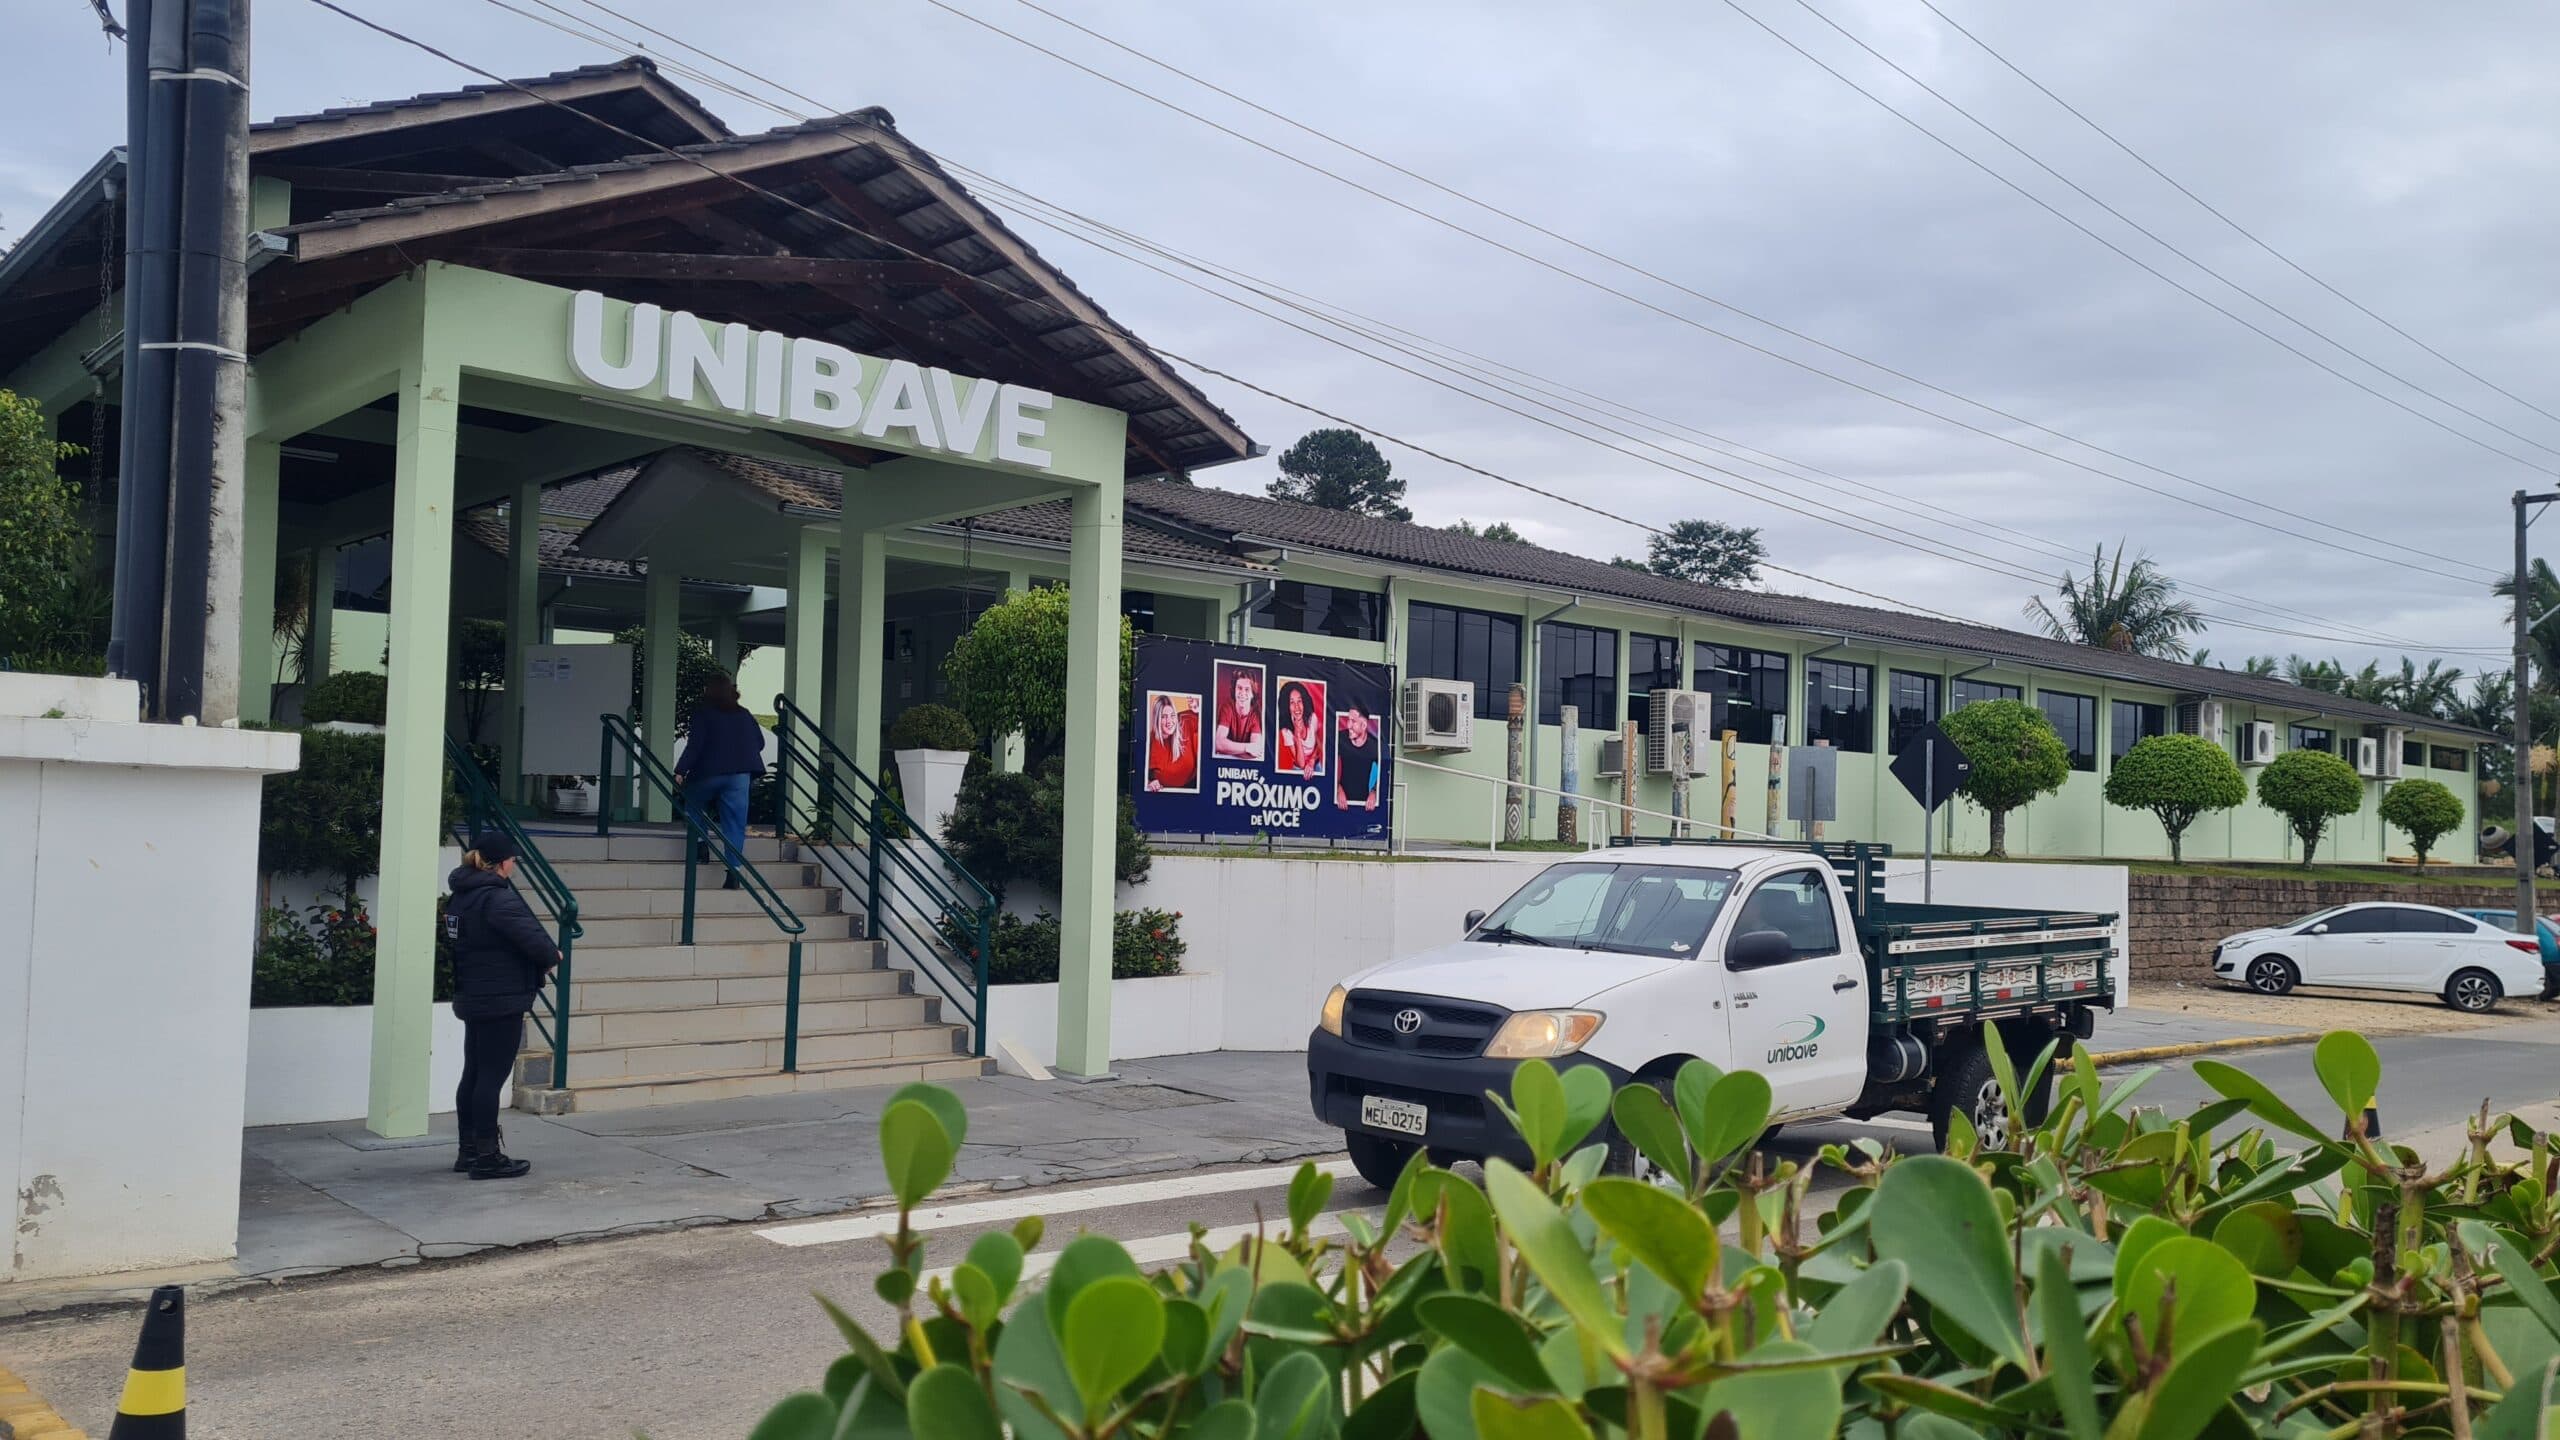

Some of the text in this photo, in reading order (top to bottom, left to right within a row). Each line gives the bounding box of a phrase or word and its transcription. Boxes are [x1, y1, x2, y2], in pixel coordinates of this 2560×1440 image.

[567, 289, 1053, 468] UNIBAVE
[1217, 767, 1259, 781] UNIBAVE
[1216, 776, 1321, 811] PRÓXIMO
[1250, 807, 1300, 828] DE VOCÊ
[1767, 1043, 1818, 1064] unibave
